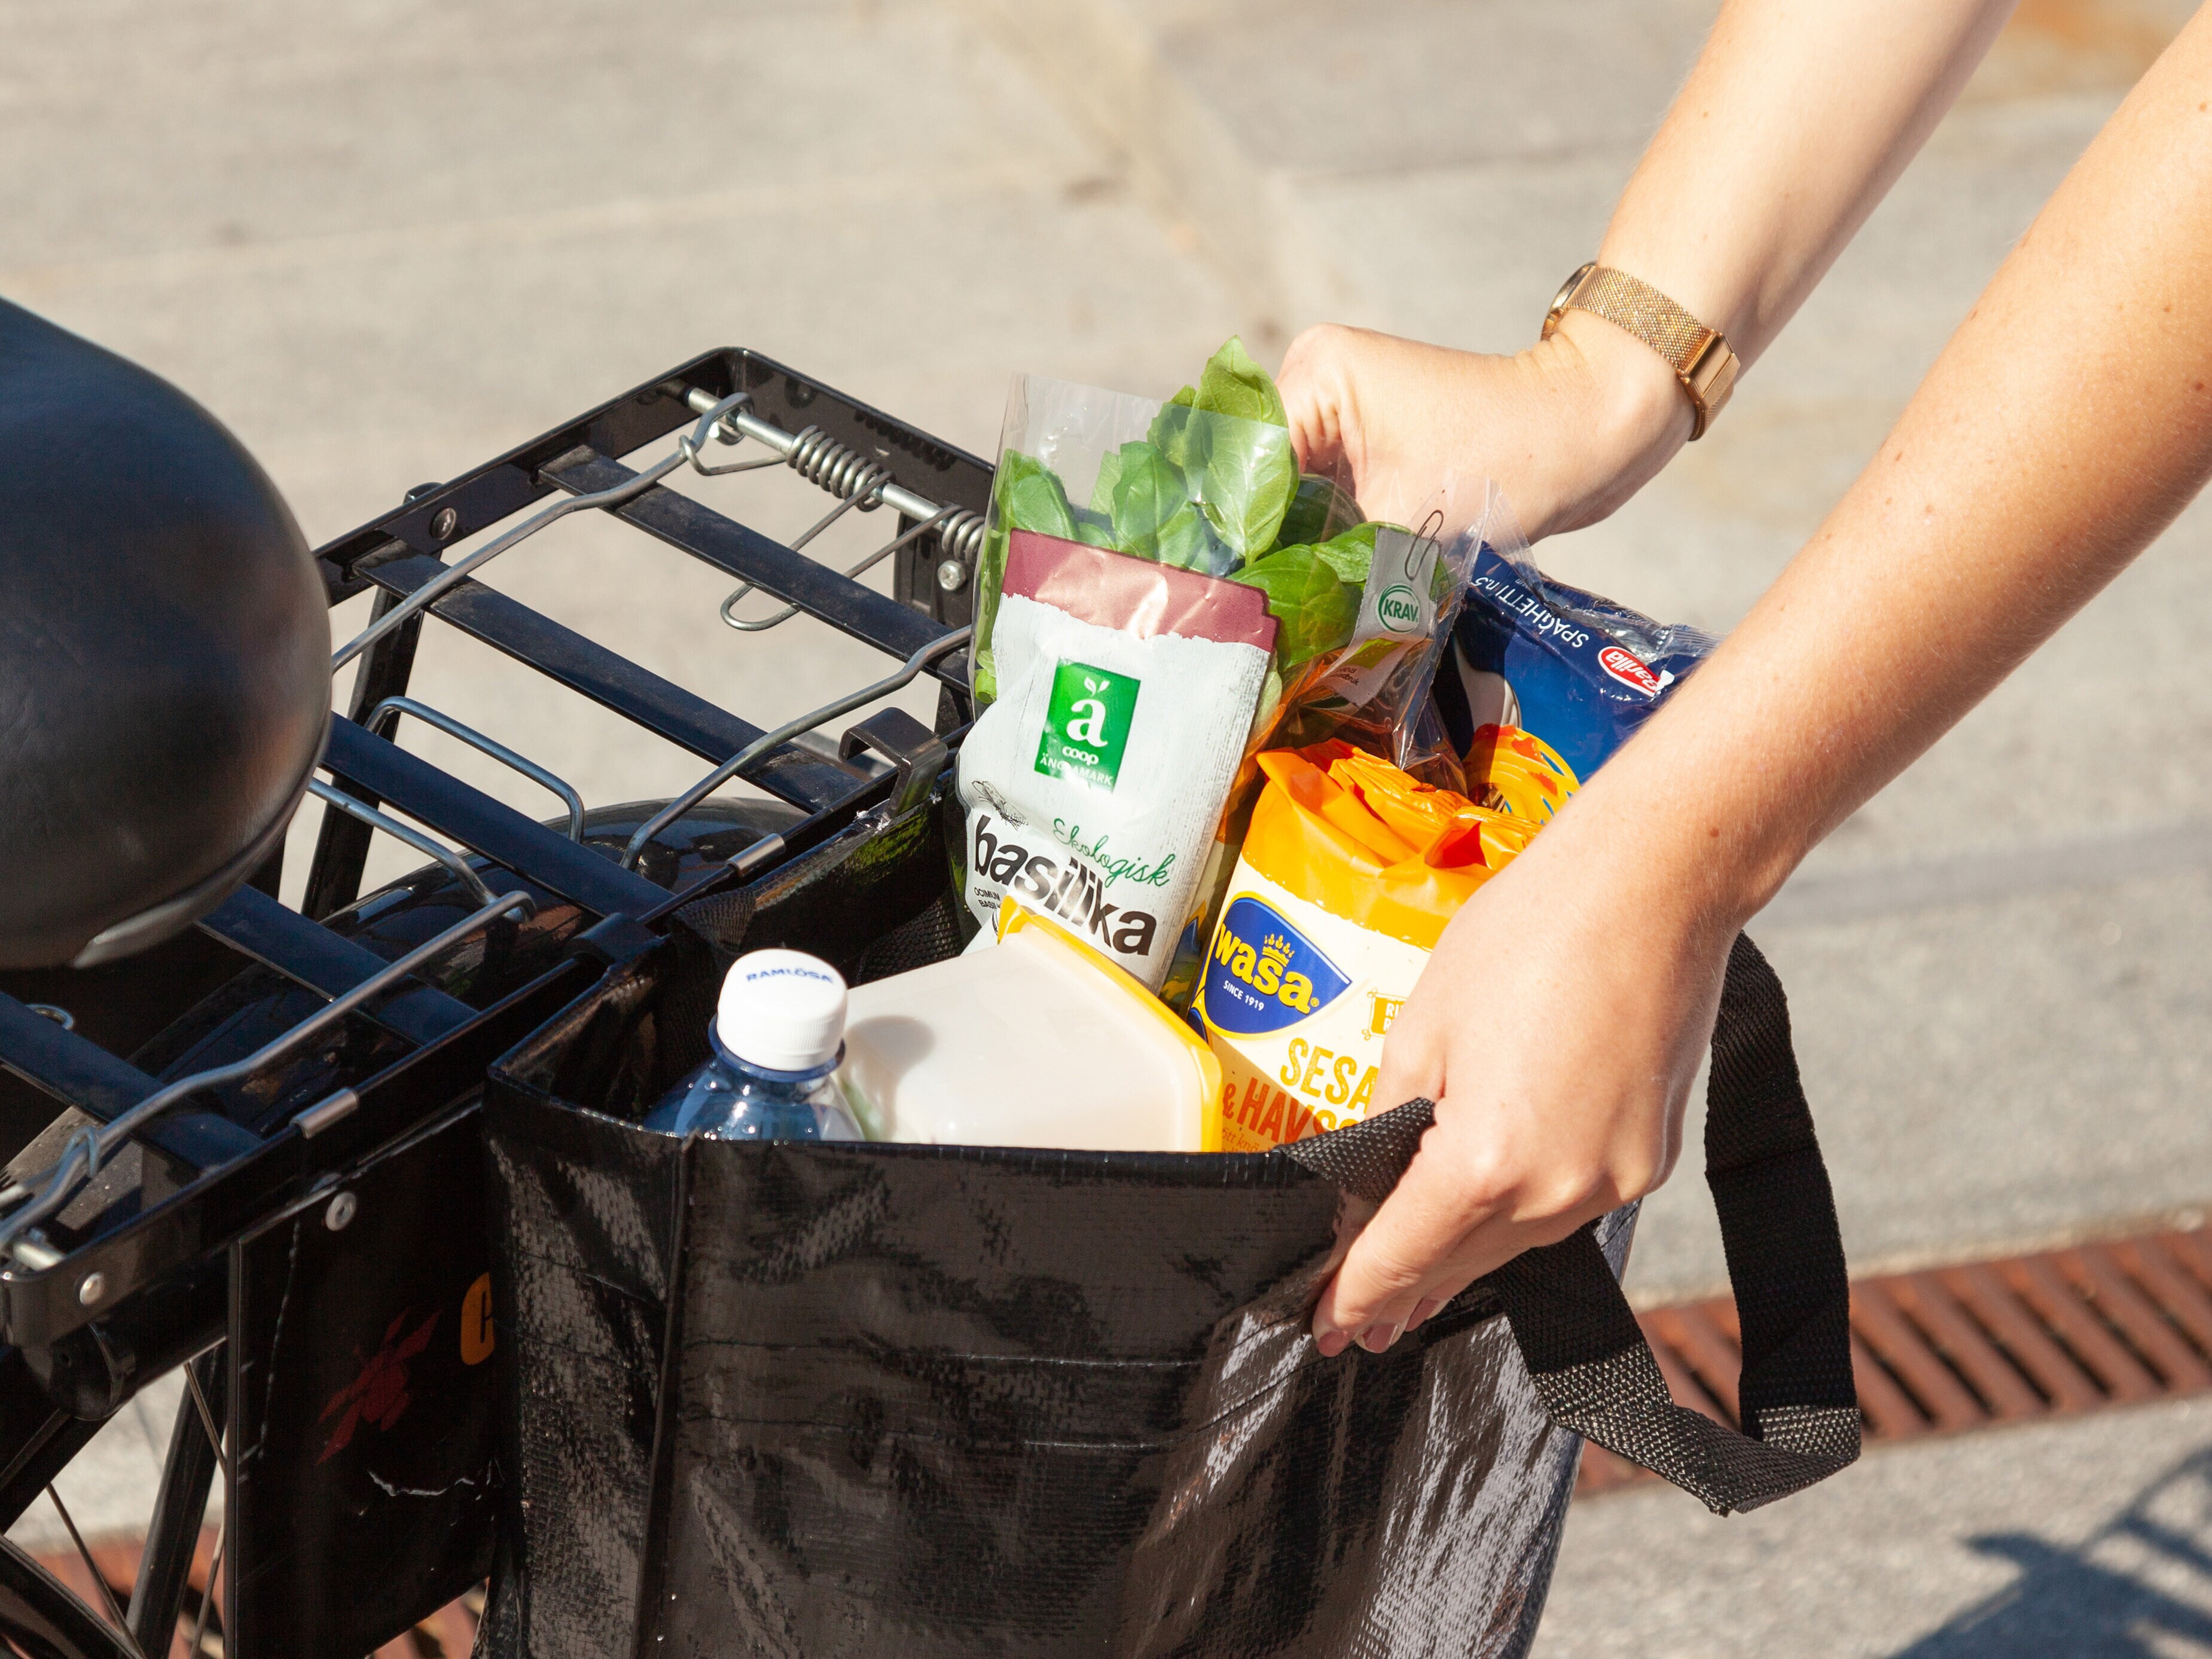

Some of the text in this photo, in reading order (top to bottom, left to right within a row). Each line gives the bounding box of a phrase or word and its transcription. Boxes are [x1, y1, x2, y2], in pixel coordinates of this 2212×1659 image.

[1383, 598, 1419, 622] KRAV
[1470, 576, 1589, 648] SPAGHETTI n.5
[1605, 650, 1658, 691] Barilla
[1040, 752, 1114, 786] ÄNGAMARK
[1061, 746, 1099, 766] coop
[1052, 818, 1176, 888] Ekologisk
[974, 814, 1158, 957] basilika
[1223, 980, 1265, 1012] SINCE 1919
